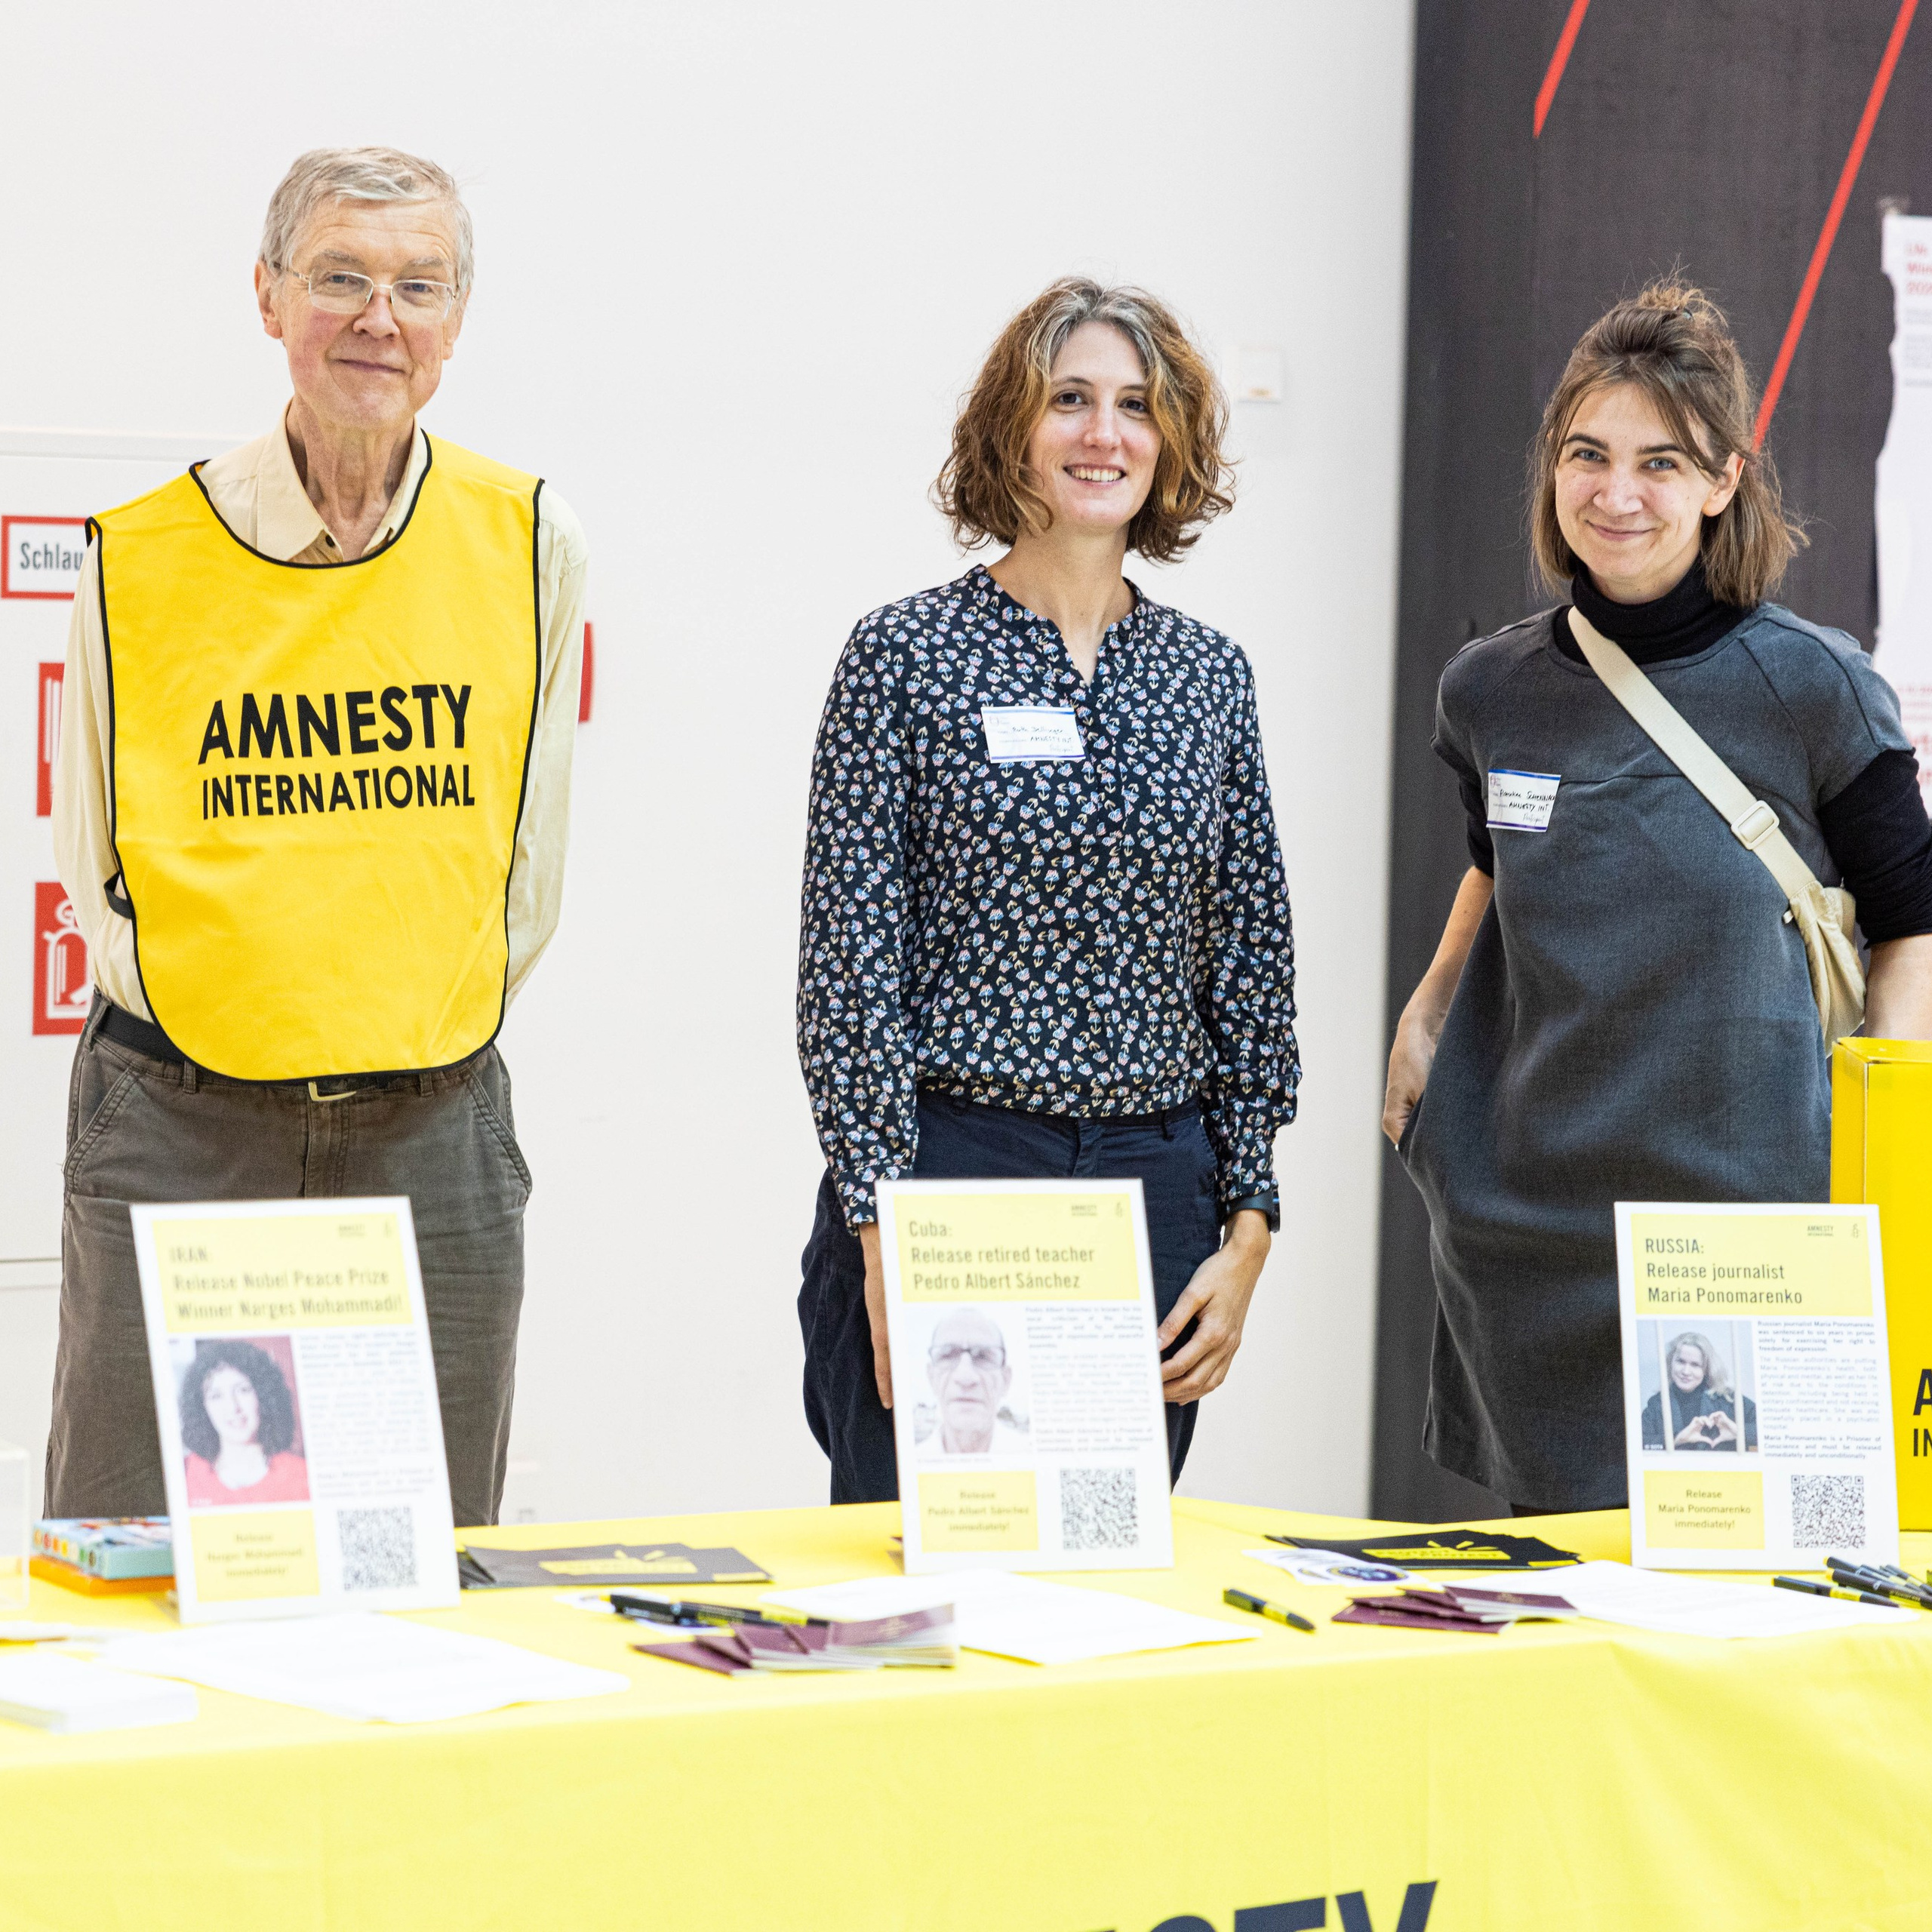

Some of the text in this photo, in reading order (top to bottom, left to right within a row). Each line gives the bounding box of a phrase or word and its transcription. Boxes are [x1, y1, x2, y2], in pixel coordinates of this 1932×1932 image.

[198, 684, 472, 764] AMNESTY
[203, 764, 475, 820] INTERNATIONAL
[909, 1221, 952, 1237] Cuba:
[912, 1246, 1096, 1263] Release retired teacher
[1645, 1238, 1705, 1254] RUSSIA:
[173, 1267, 389, 1292] Release Nobel Peace Prize
[1647, 1263, 1785, 1281] Release journalist
[914, 1272, 1081, 1291] Pedro Albert Sánchez
[1648, 1287, 1803, 1304] Maria Ponomarenko
[177, 1302, 233, 1320] Winner
[239, 1299, 296, 1321] Narges
[1685, 1490, 1723, 1499] Release
[1658, 1504, 1751, 1514] Maria Ponomarenko
[1675, 1519, 1735, 1530] immediately!
